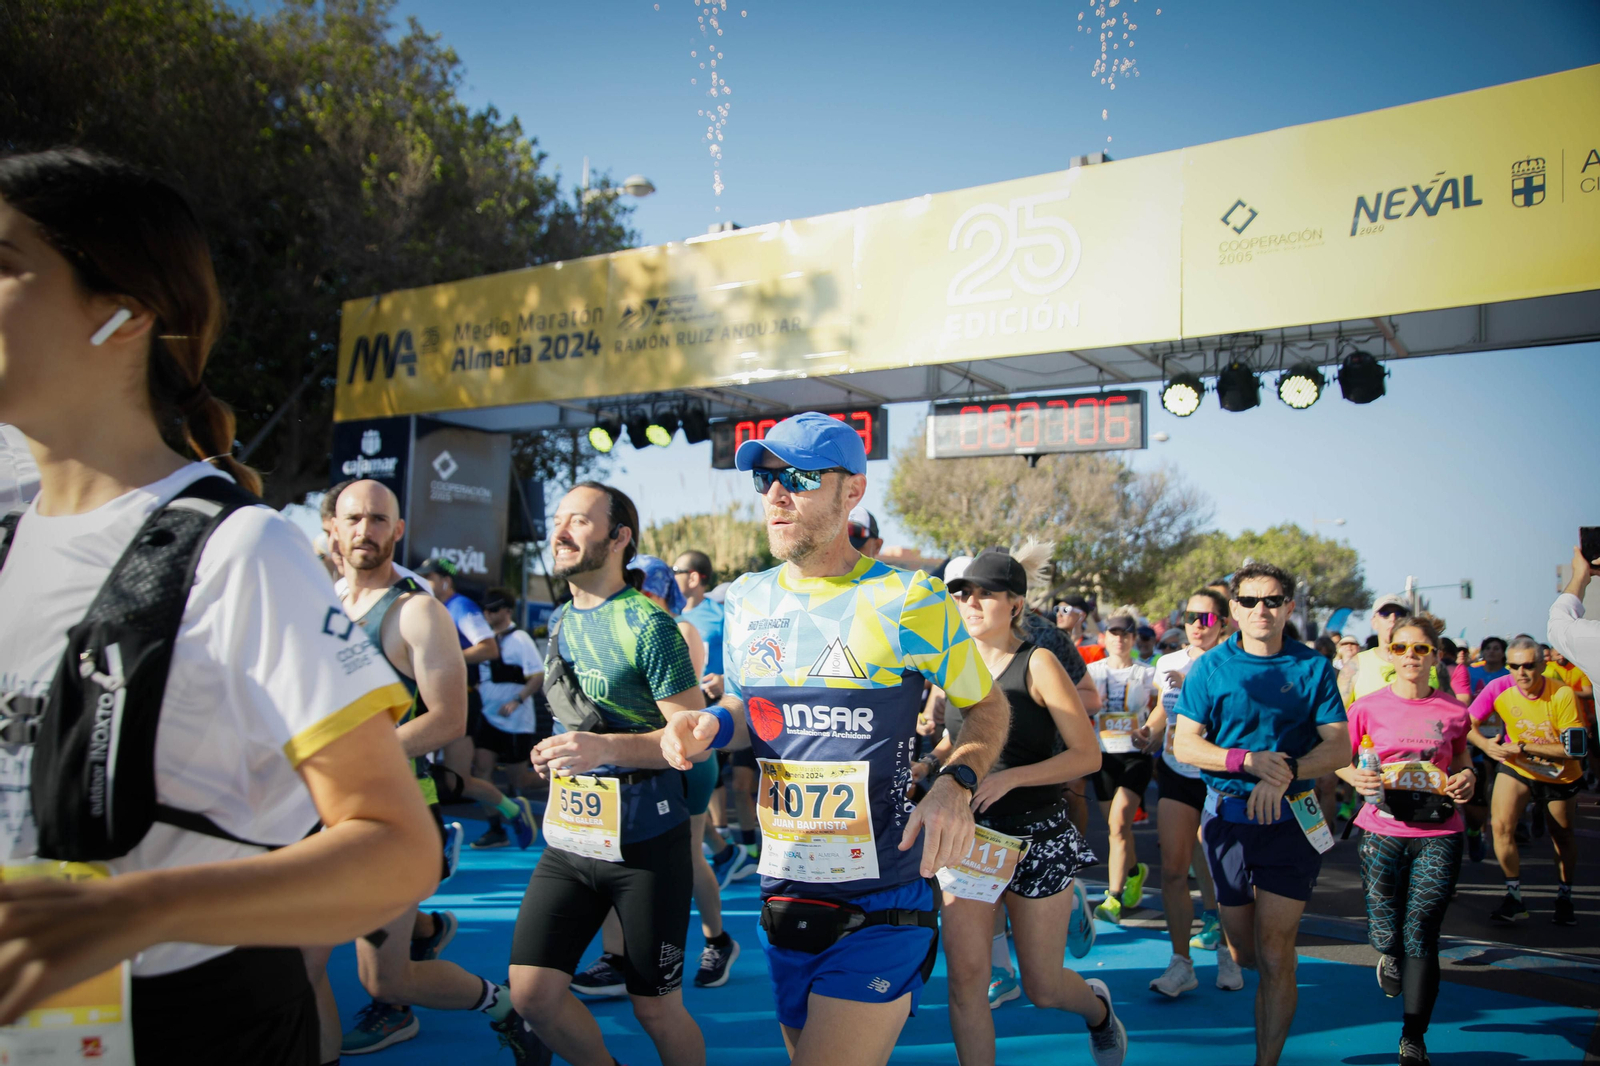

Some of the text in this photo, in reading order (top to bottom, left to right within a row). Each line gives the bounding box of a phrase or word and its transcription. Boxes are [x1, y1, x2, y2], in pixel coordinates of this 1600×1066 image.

[1350, 171, 1483, 237] NEXAL
[1218, 227, 1323, 253] COOPERACIÓN
[1359, 224, 1385, 235] 2020
[947, 188, 1082, 306] 25
[453, 302, 604, 342] Medio Maratón
[948, 298, 1080, 341] EDICIÓN
[614, 315, 801, 354] RAMÓN RUIZ ANDÚJAR
[451, 328, 602, 372] Almería 2024
[342, 455, 399, 479] cajamar
[783, 703, 874, 732] INSAR
[1105, 718, 1132, 731] 942
[786, 727, 872, 740] Instalaciones Archidona
[1385, 771, 1442, 789] 1433
[561, 788, 601, 817] 559
[768, 781, 857, 820] 1072
[575, 817, 604, 826] GALERA
[772, 818, 848, 831] JUAN BAUTISTA
